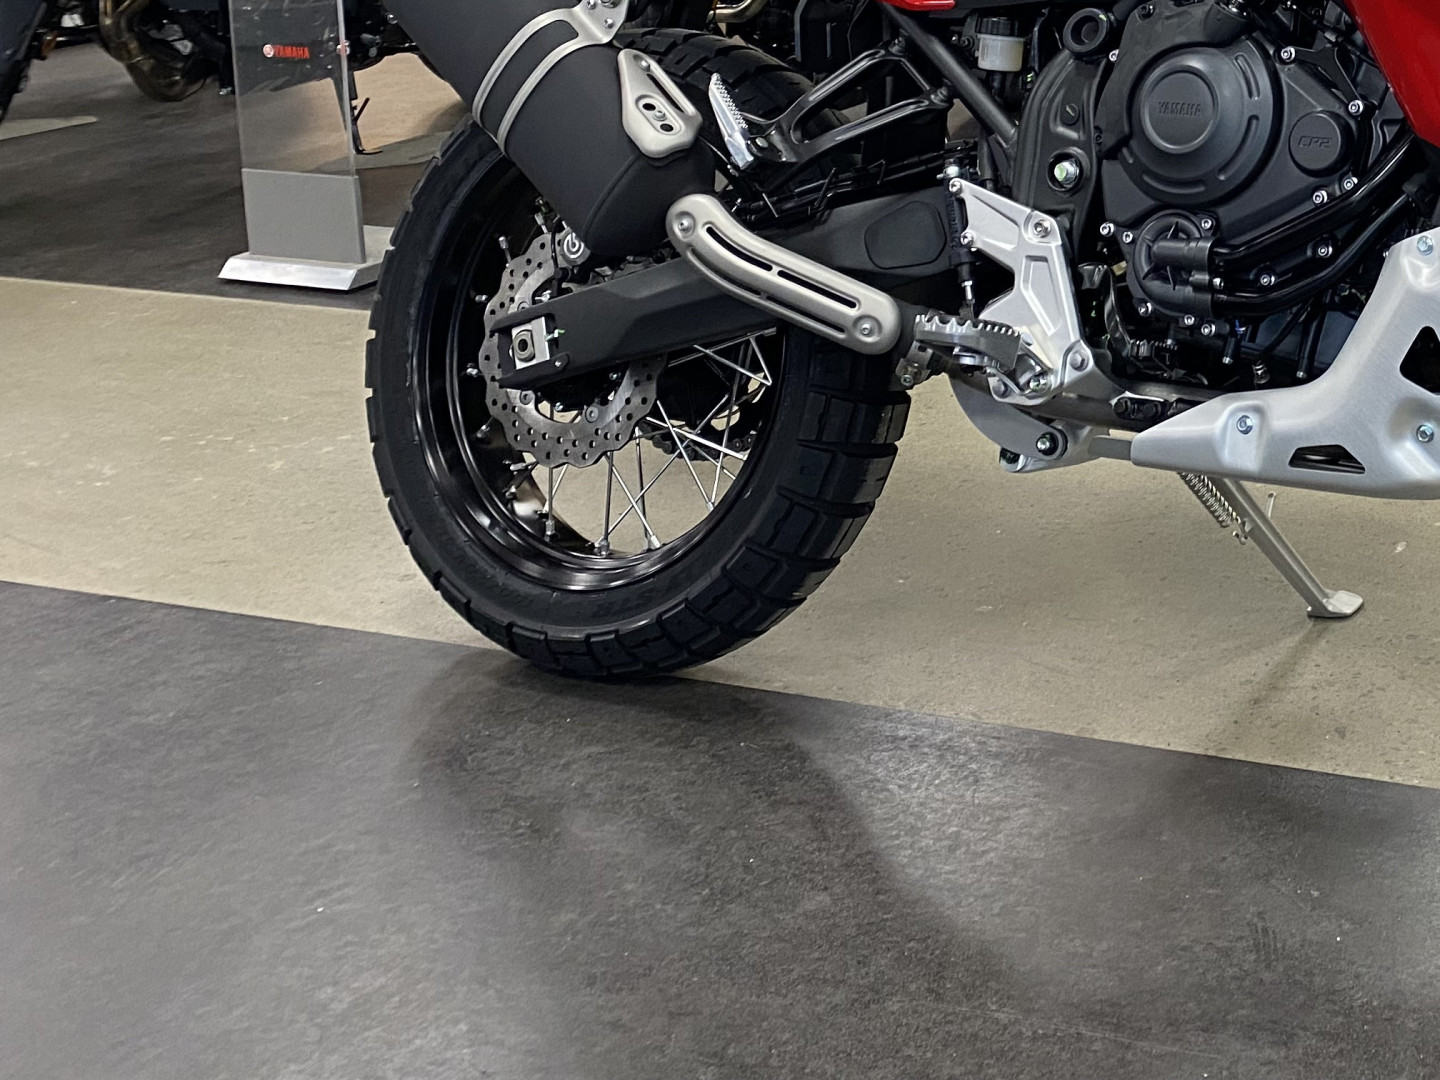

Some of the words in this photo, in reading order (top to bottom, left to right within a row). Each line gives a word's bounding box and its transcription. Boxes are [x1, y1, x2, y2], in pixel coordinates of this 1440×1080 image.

[273, 44, 310, 59] YAMAHA
[1158, 100, 1202, 119] YAMAHA
[1297, 134, 1333, 149] CP2
